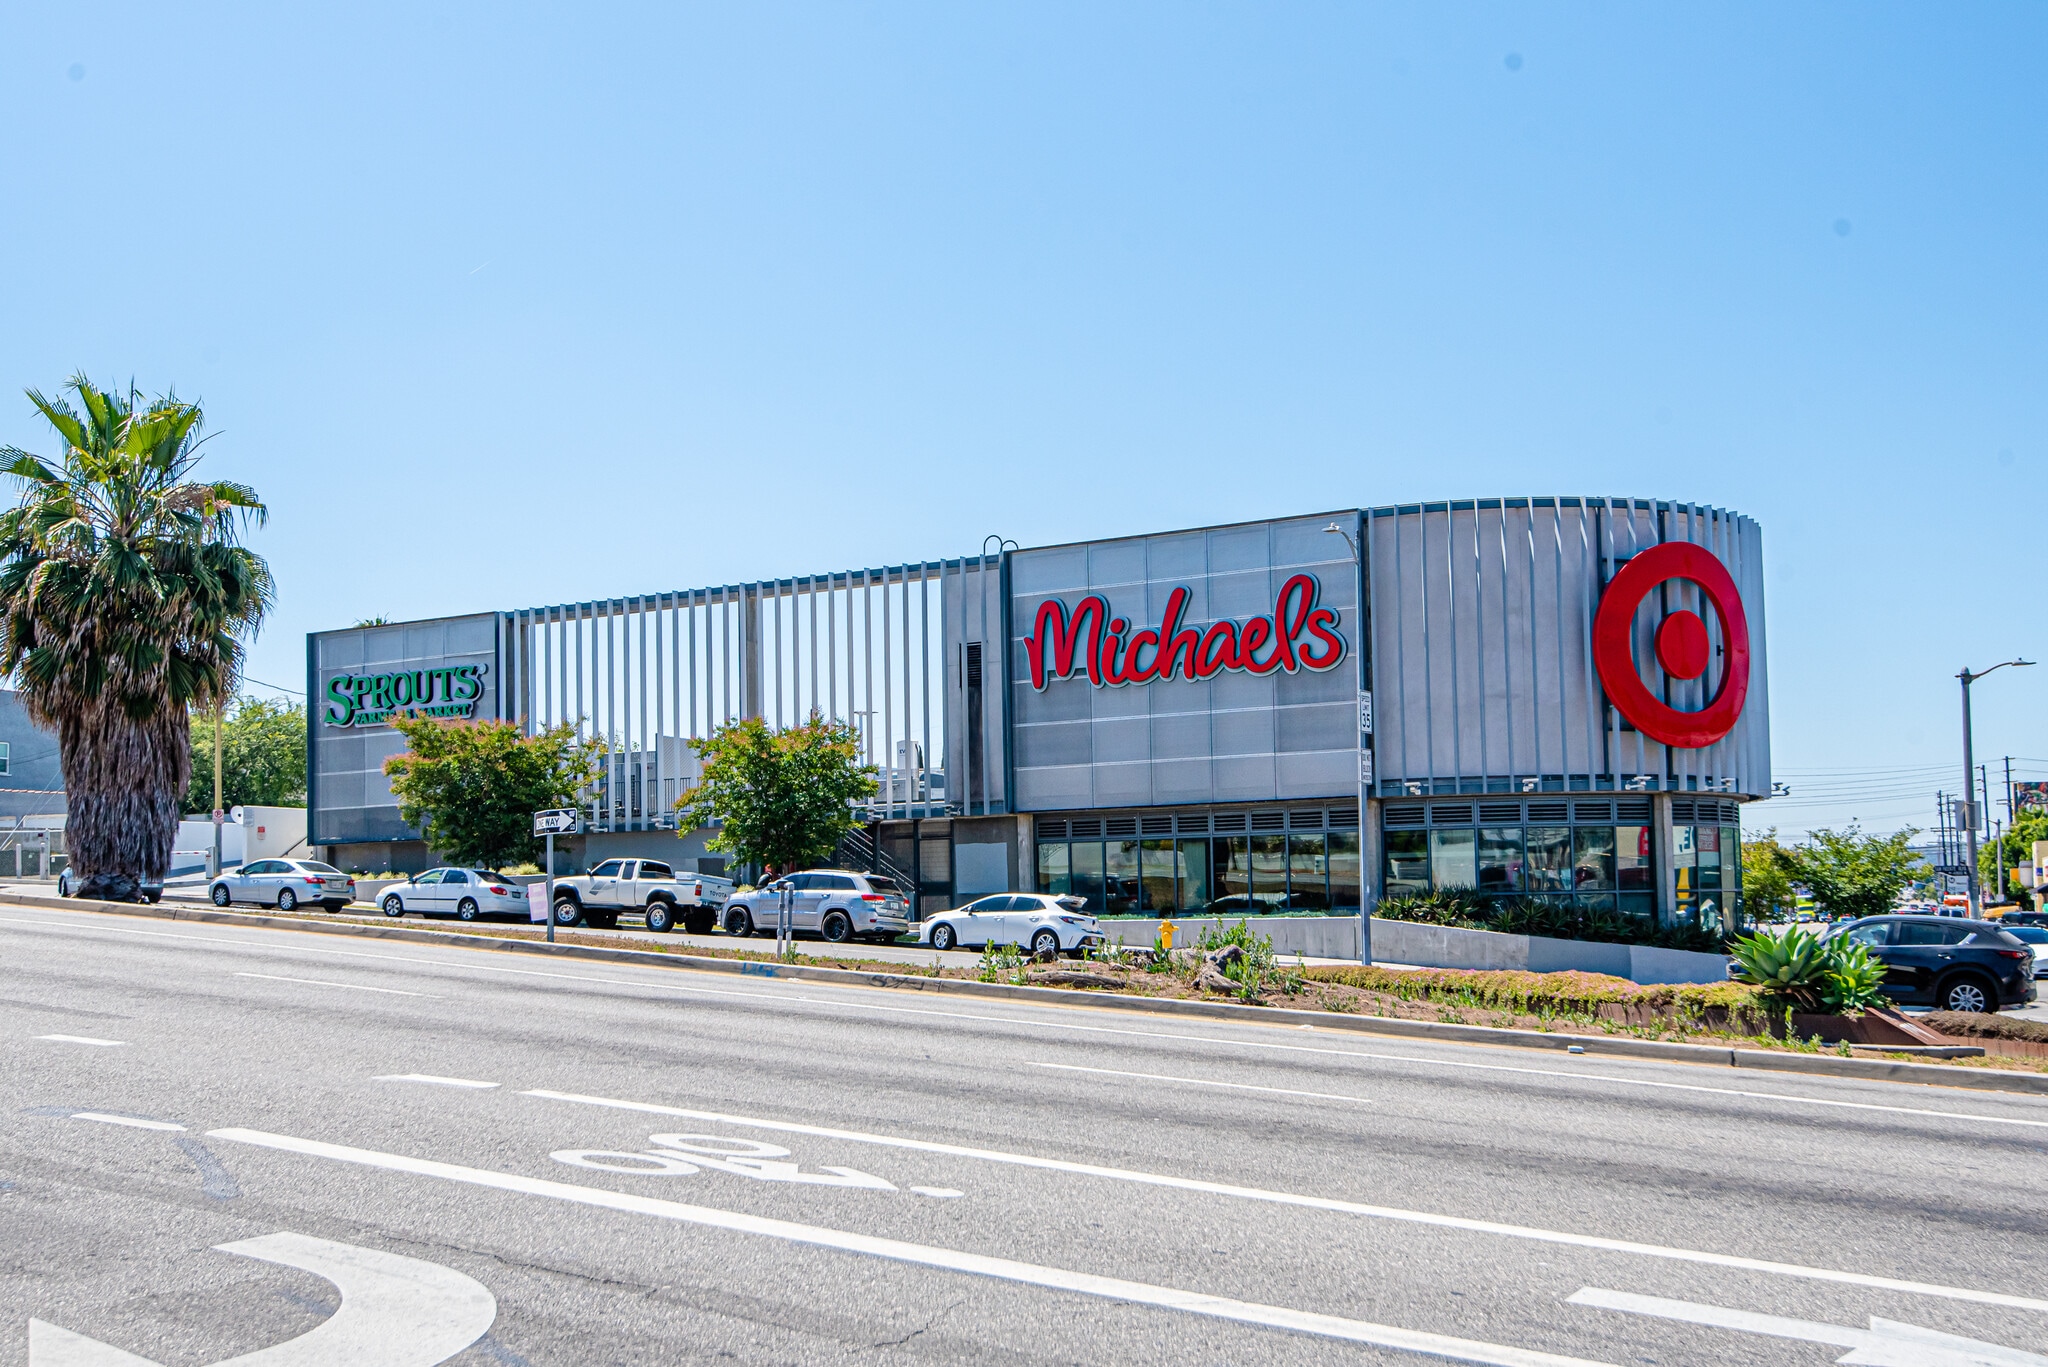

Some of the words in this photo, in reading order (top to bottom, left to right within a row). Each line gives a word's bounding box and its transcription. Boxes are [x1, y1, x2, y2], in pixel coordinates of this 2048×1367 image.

[1023, 573, 1342, 690] Michaels
[323, 665, 476, 726] SPROUTS
[1362, 713, 1371, 729] 35
[546, 817, 559, 827] WAY
[709, 890, 727, 898] TOYOTA
